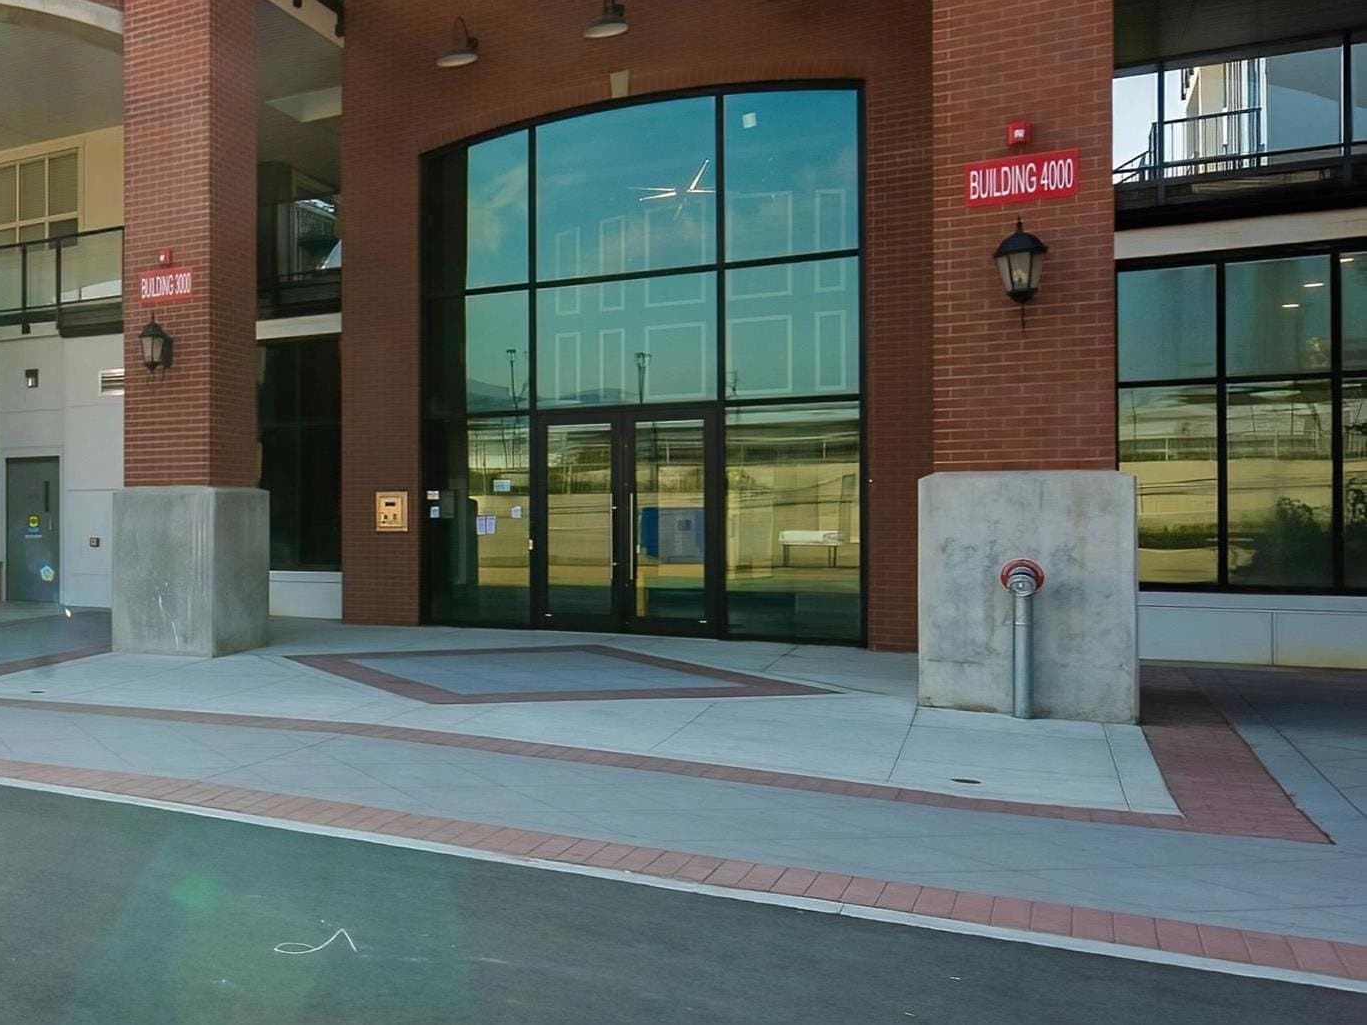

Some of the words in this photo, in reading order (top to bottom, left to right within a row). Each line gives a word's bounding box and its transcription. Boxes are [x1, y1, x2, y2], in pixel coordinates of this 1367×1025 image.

[970, 163, 1037, 200] BUILDING
[1040, 159, 1074, 191] 4000
[141, 274, 174, 299] BUILDING
[175, 272, 191, 295] 3000
